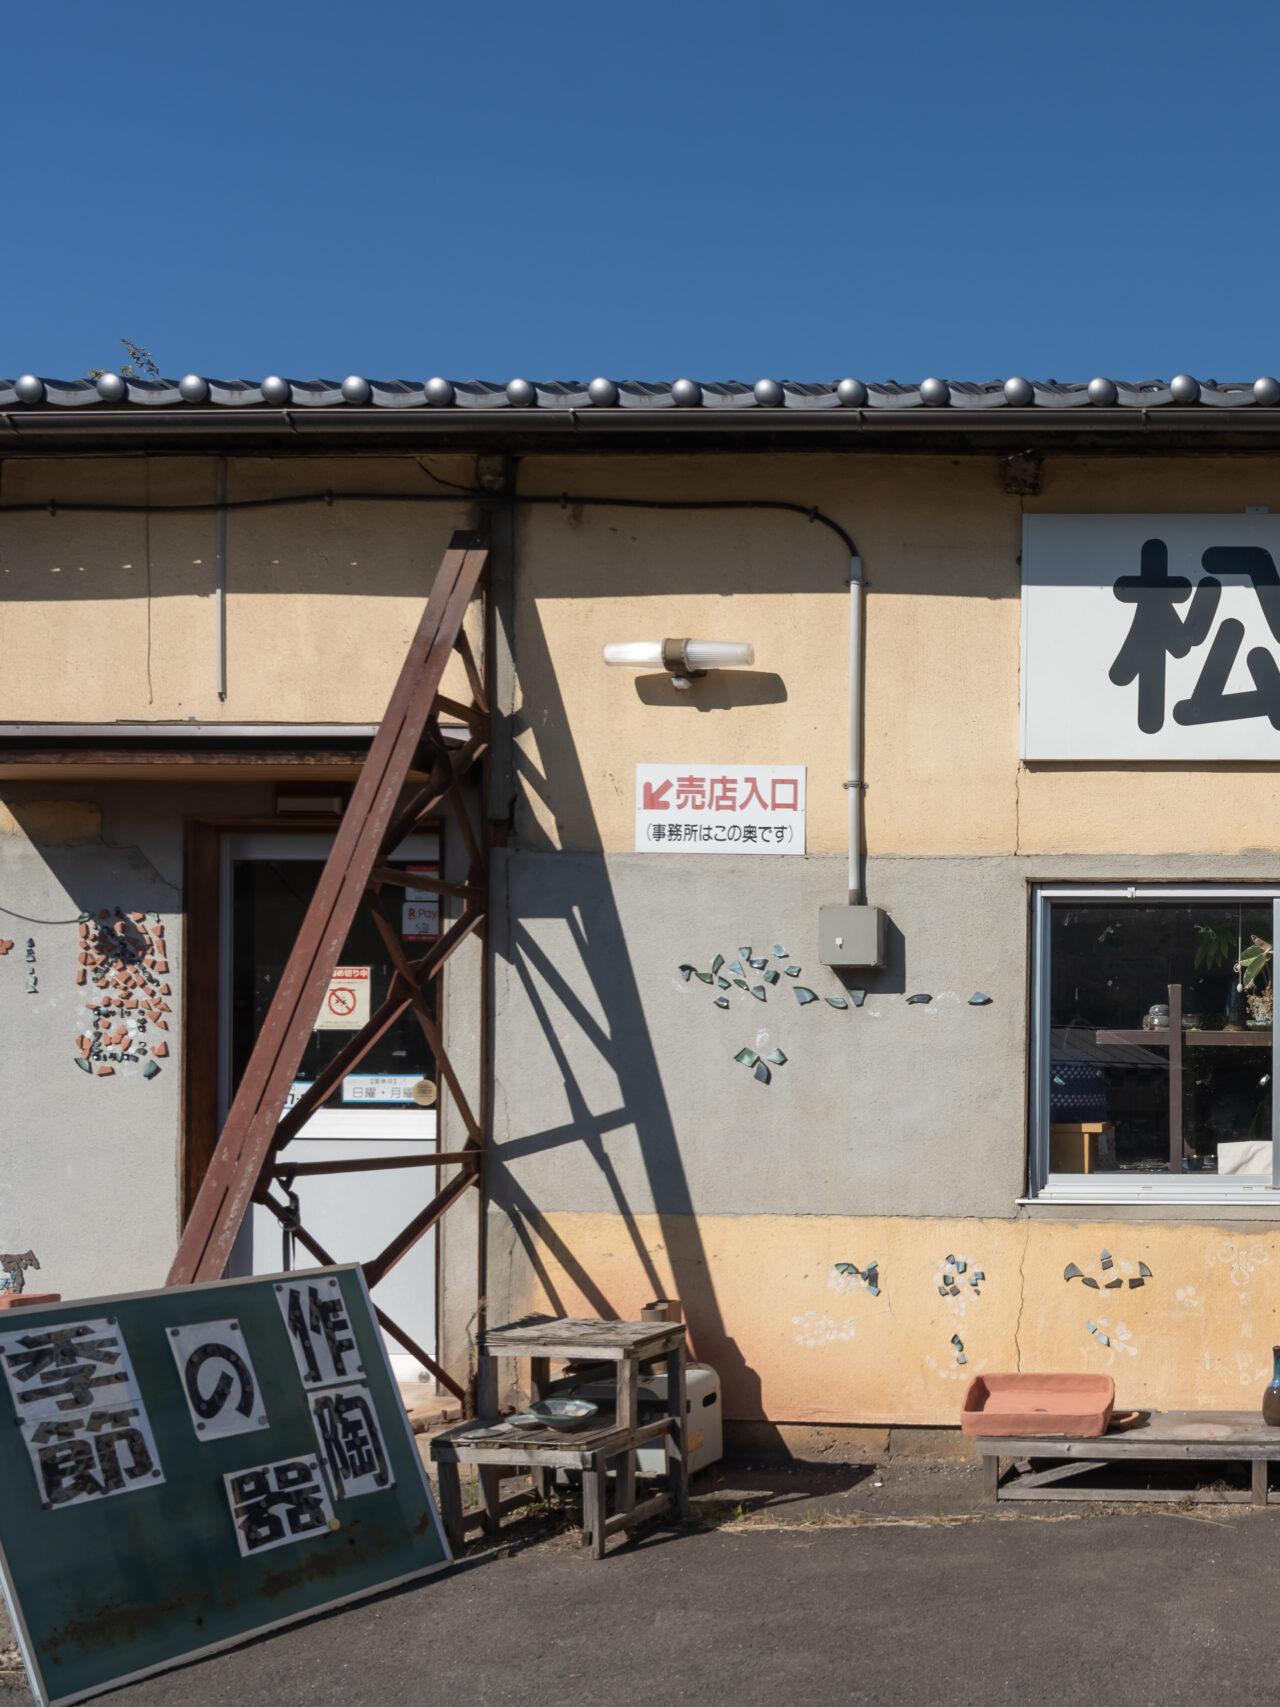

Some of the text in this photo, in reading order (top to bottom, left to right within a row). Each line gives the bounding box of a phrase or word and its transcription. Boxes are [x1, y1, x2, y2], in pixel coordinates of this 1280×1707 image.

[675, 774, 799, 812] 売店入口
[646, 823, 794, 844] （事務所はこの奥です）
[185, 1342, 255, 1419] の
[5, 1323, 155, 1506] 季節
